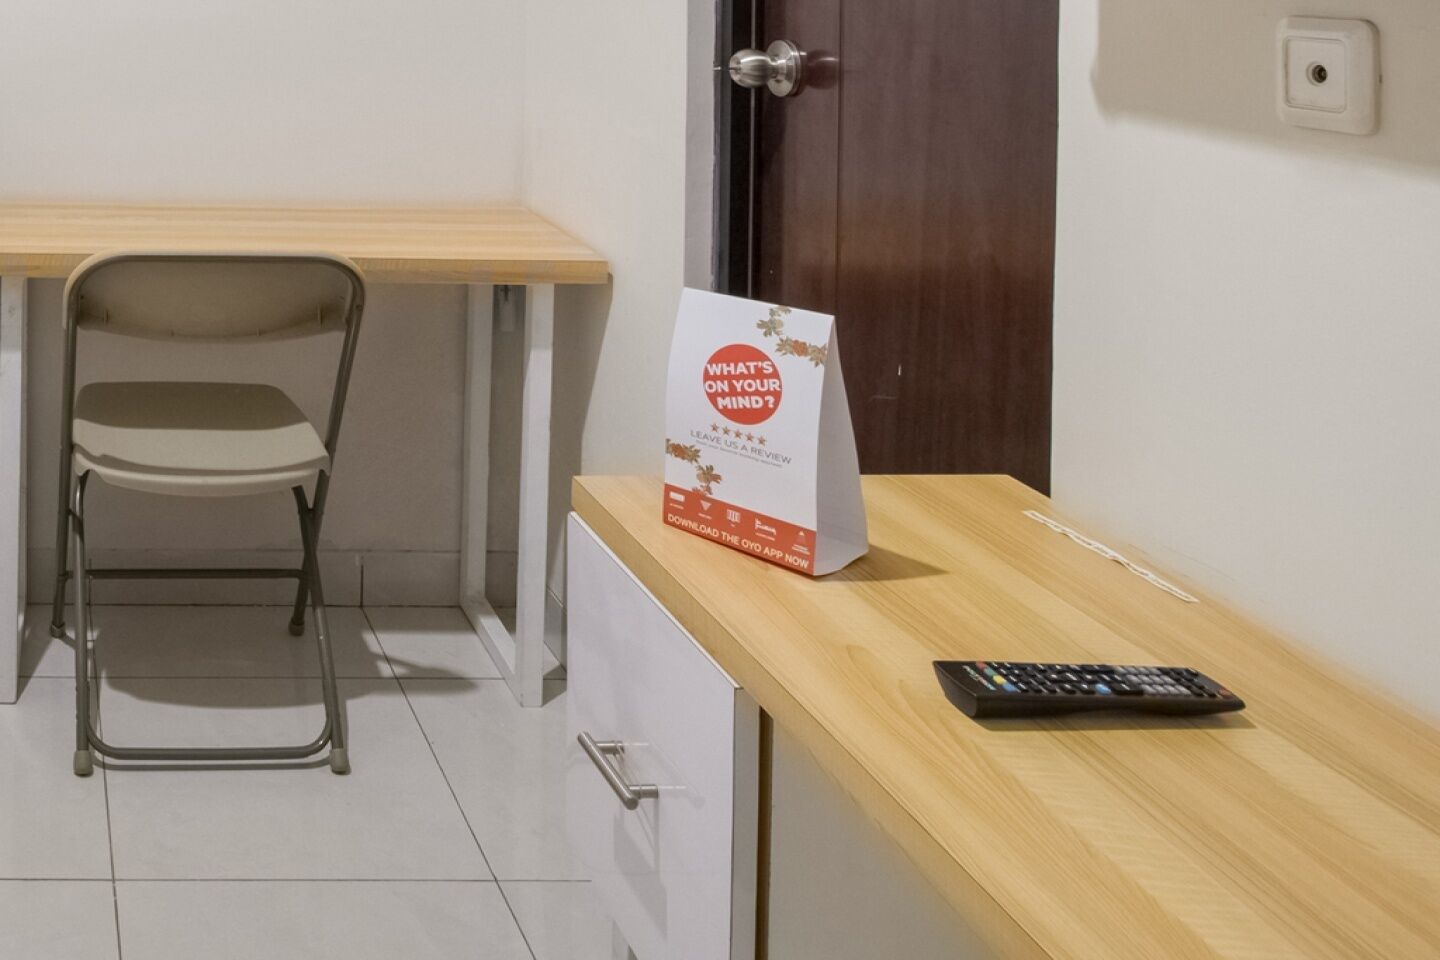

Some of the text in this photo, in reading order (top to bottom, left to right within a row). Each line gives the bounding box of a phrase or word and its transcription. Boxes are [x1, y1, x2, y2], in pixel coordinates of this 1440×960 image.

[706, 361, 774, 376] WHAT'S
[705, 378, 781, 393] ON YOUR
[716, 394, 776, 410] MIND?
[690, 429, 722, 444] LEAVE
[724, 439, 739, 450] US
[740, 443, 749, 452] A
[750, 446, 792, 465] REVIEW
[667, 512, 720, 538] DOWNLOAD
[720, 530, 740, 547] THE
[741, 538, 762, 553] OYO
[763, 546, 784, 560] APP
[784, 553, 810, 570] NOW
